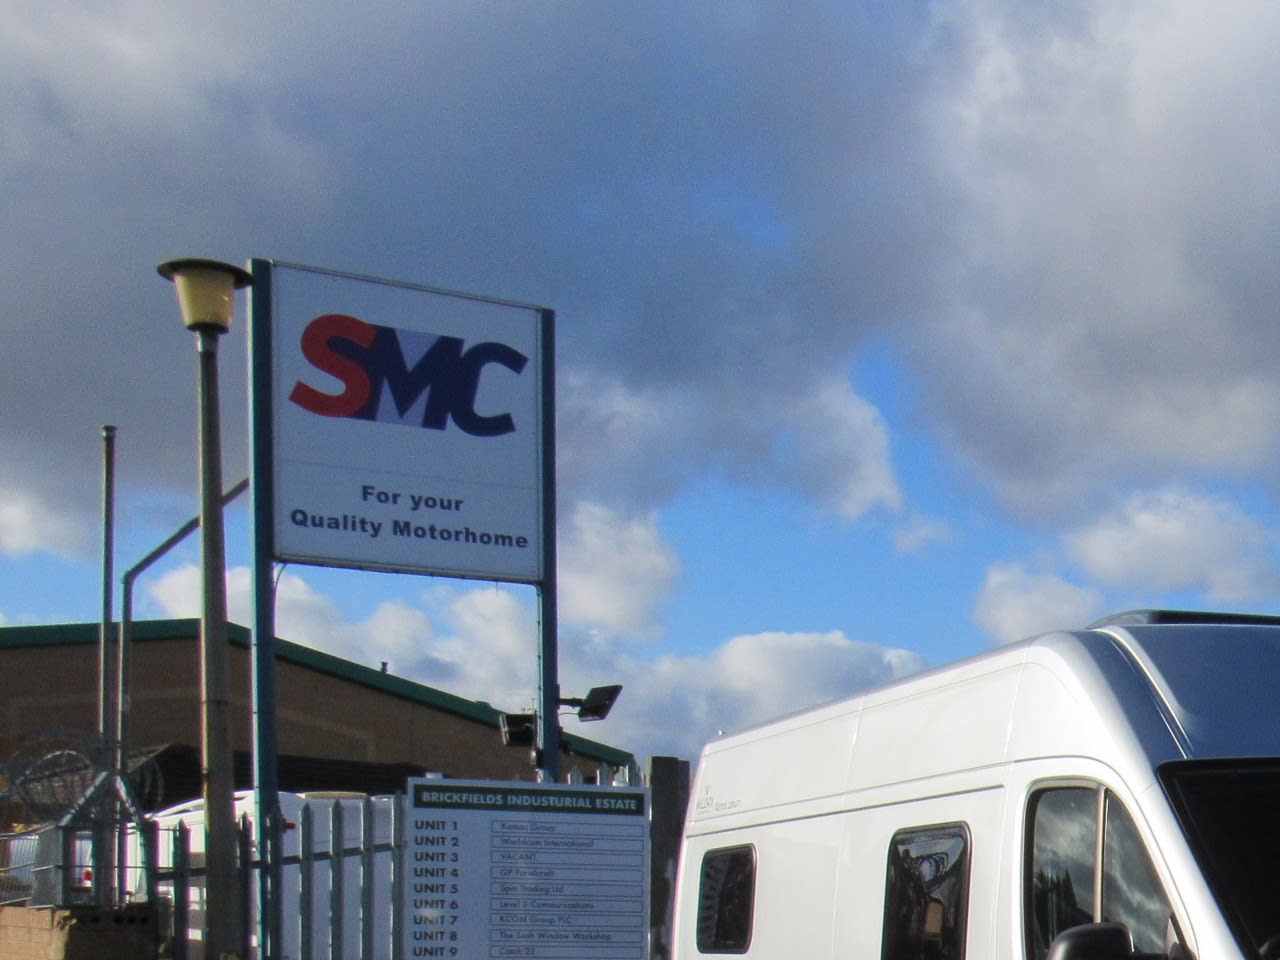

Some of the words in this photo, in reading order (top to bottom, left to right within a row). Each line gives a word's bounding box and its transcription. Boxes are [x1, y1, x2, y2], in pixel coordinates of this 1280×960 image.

[288, 313, 528, 437] SMC
[361, 485, 401, 505] For
[410, 494, 464, 511] your
[290, 509, 383, 538] Quality
[392, 519, 529, 549] Motorhome
[422, 791, 503, 805] BRICKFIELDS
[507, 794, 592, 809] INDUSTURIAL
[596, 798, 637, 810] ESTATE
[415, 821, 447, 830] UNIT
[452, 821, 458, 831] 1
[415, 836, 447, 846] UNIT
[451, 837, 459, 847] 2
[415, 852, 446, 862] UNIT
[451, 852, 459, 862] 3
[501, 853, 536, 861] VACANT
[414, 868, 446, 878] UNIT
[450, 868, 458, 877] 4
[414, 884, 446, 893] UNIT
[450, 884, 458, 893] 5
[414, 899, 446, 909] UNIT
[450, 899, 458, 909] 6
[414, 915, 445, 925] UNIT
[450, 915, 458, 925] 7
[414, 931, 445, 941] UNIT
[450, 931, 457, 941] 8
[413, 947, 445, 957] UNIT
[450, 947, 457, 957] 9
